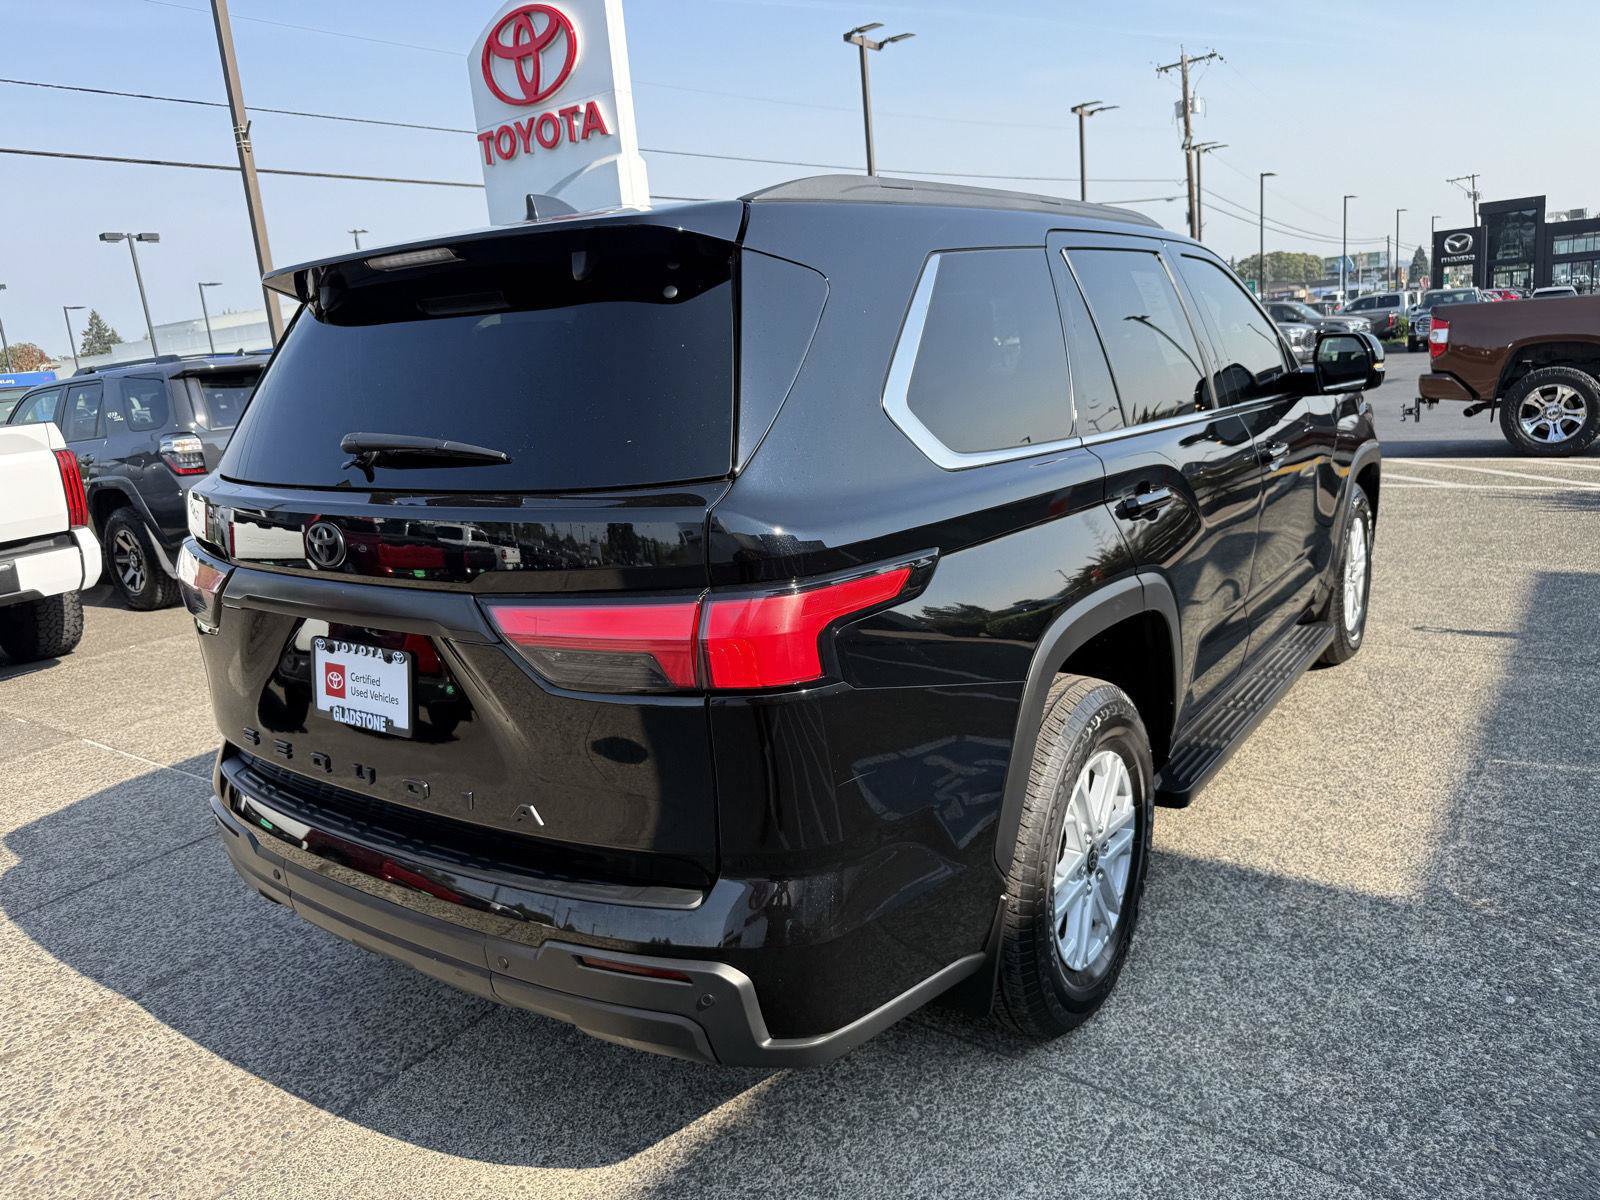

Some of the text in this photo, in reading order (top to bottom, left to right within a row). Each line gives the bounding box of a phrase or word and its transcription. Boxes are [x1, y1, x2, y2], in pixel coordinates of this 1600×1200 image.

[477, 101, 608, 165] TOYOTA
[333, 641, 385, 660] TOYOTA
[350, 672, 381, 687] Certified
[350, 686, 399, 705] Used Vehicles
[332, 705, 387, 732] GLADSTONE
[243, 727, 545, 826] SEQUOIA
